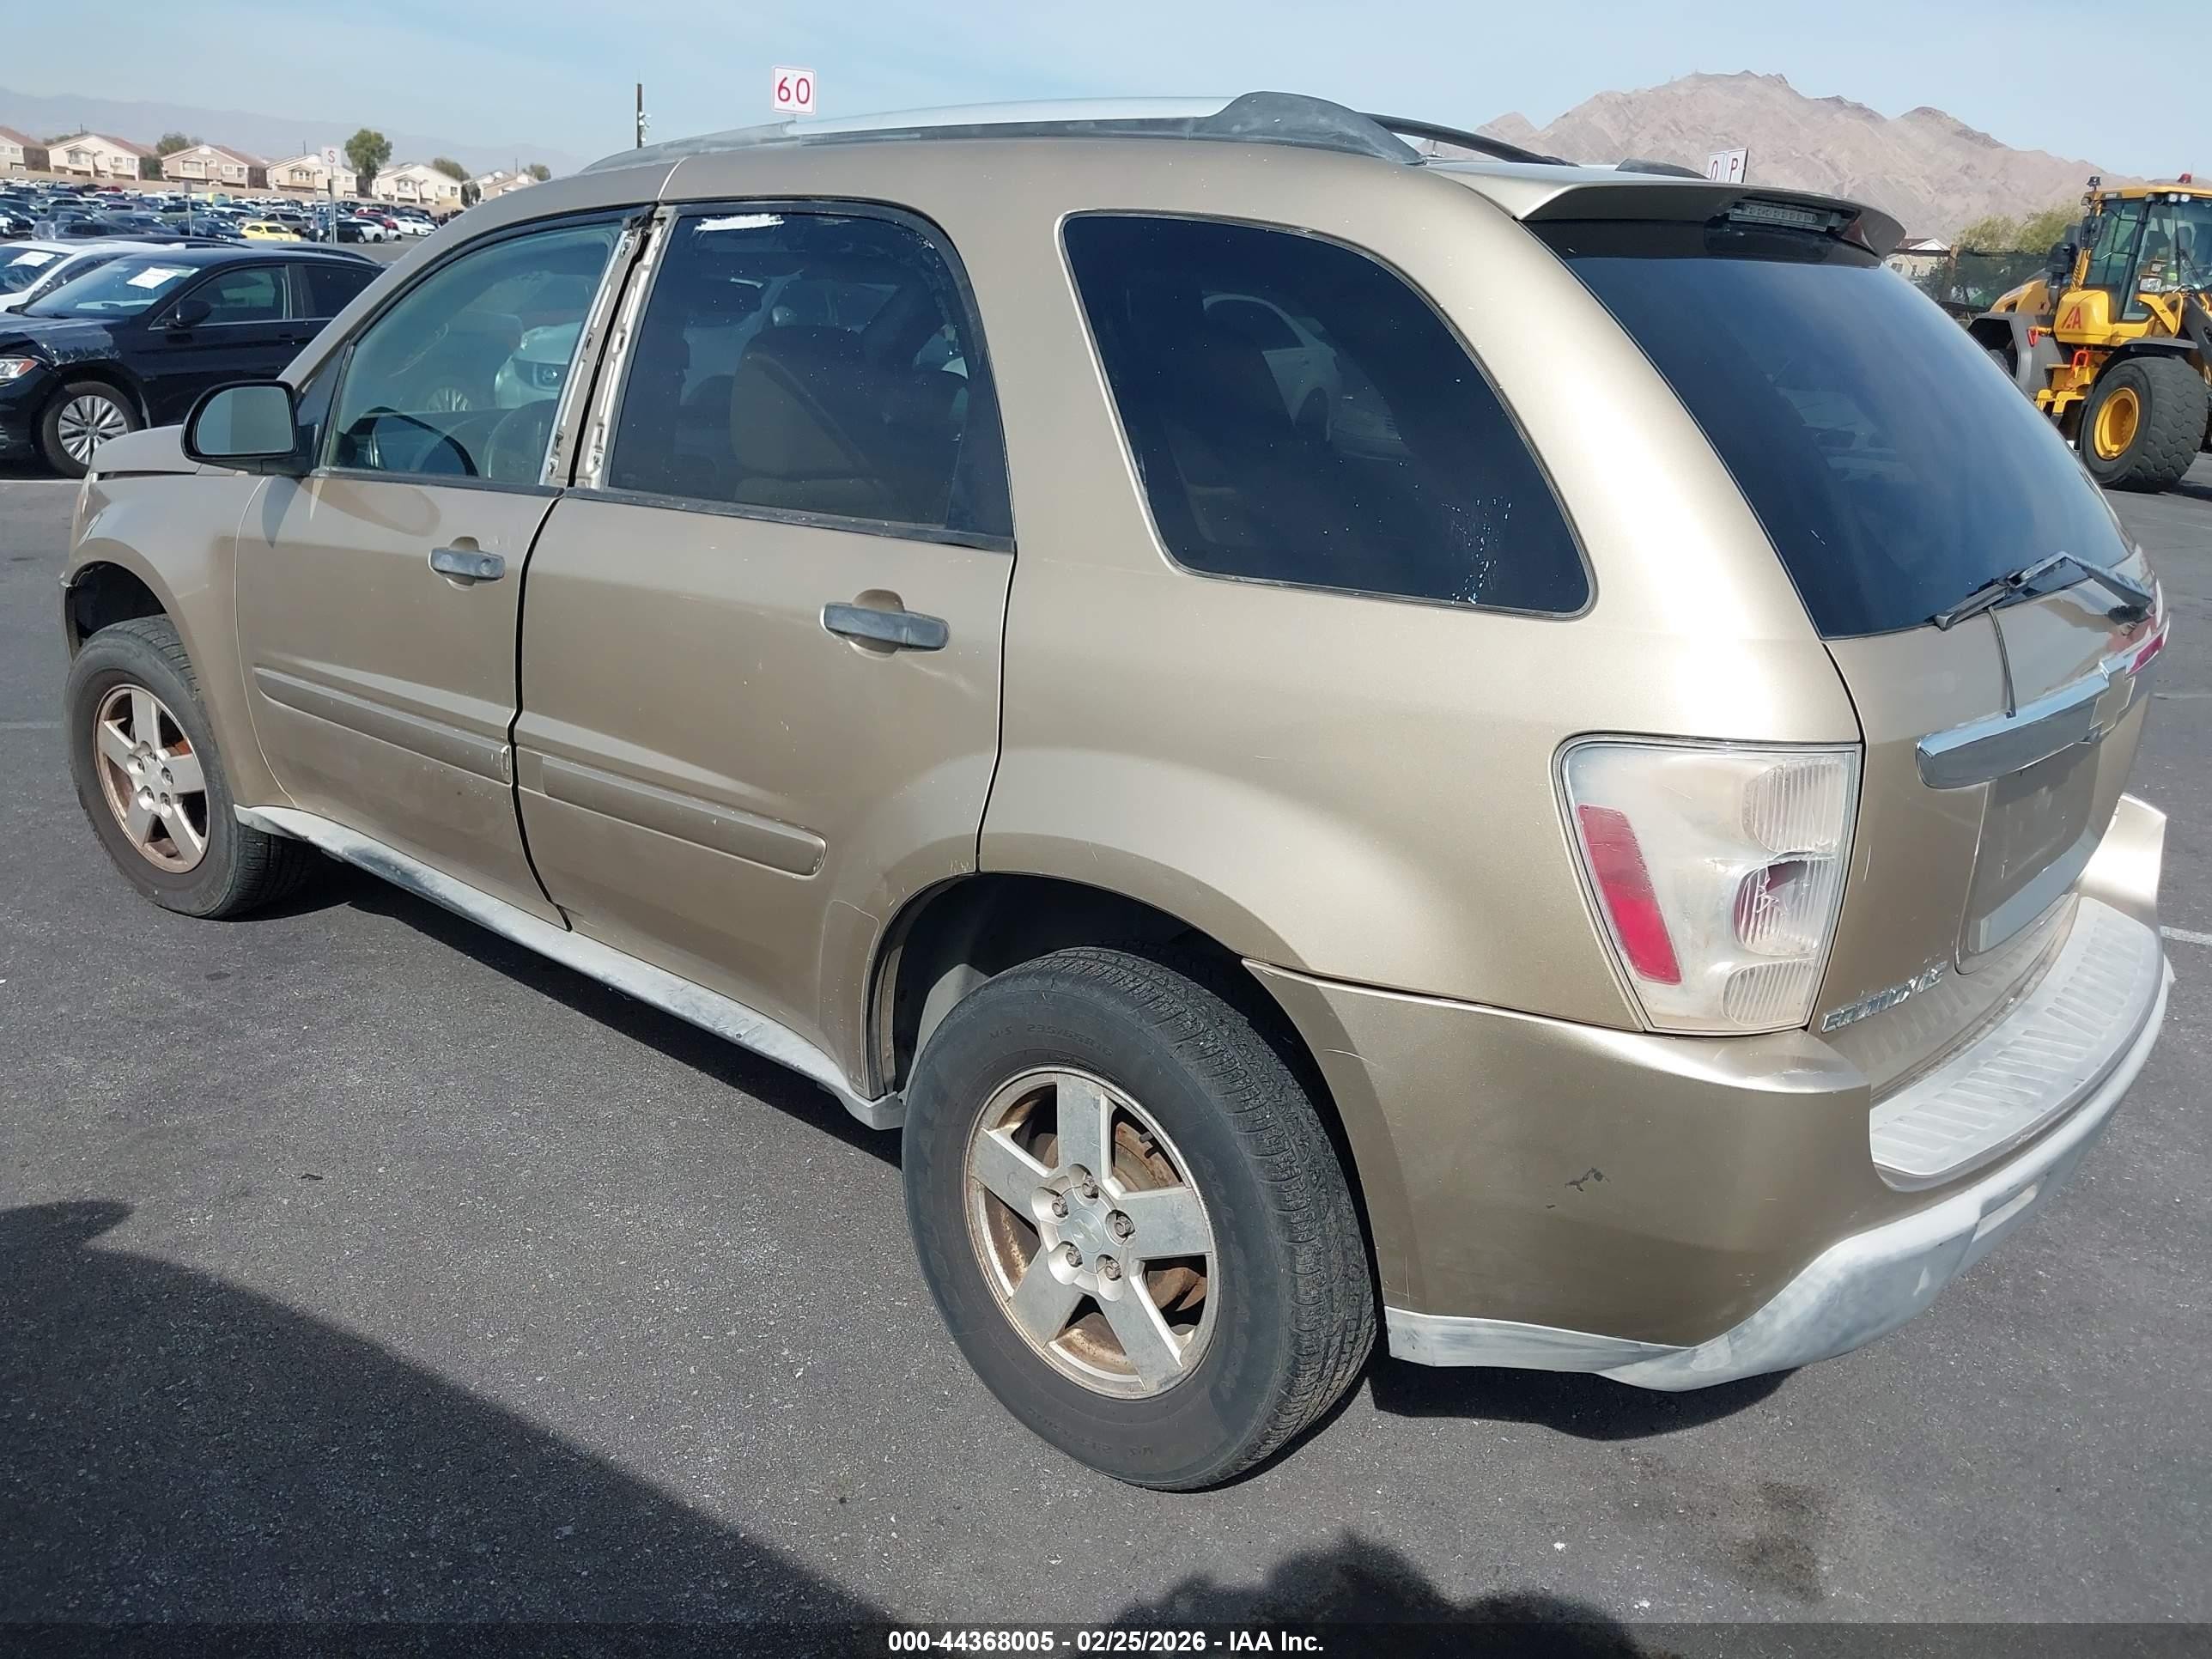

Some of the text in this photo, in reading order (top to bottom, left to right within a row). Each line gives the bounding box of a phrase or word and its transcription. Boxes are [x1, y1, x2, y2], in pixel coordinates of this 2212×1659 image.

[777, 76, 810, 105] 60
[328, 149, 336, 164] S
[1729, 157, 1739, 182] P
